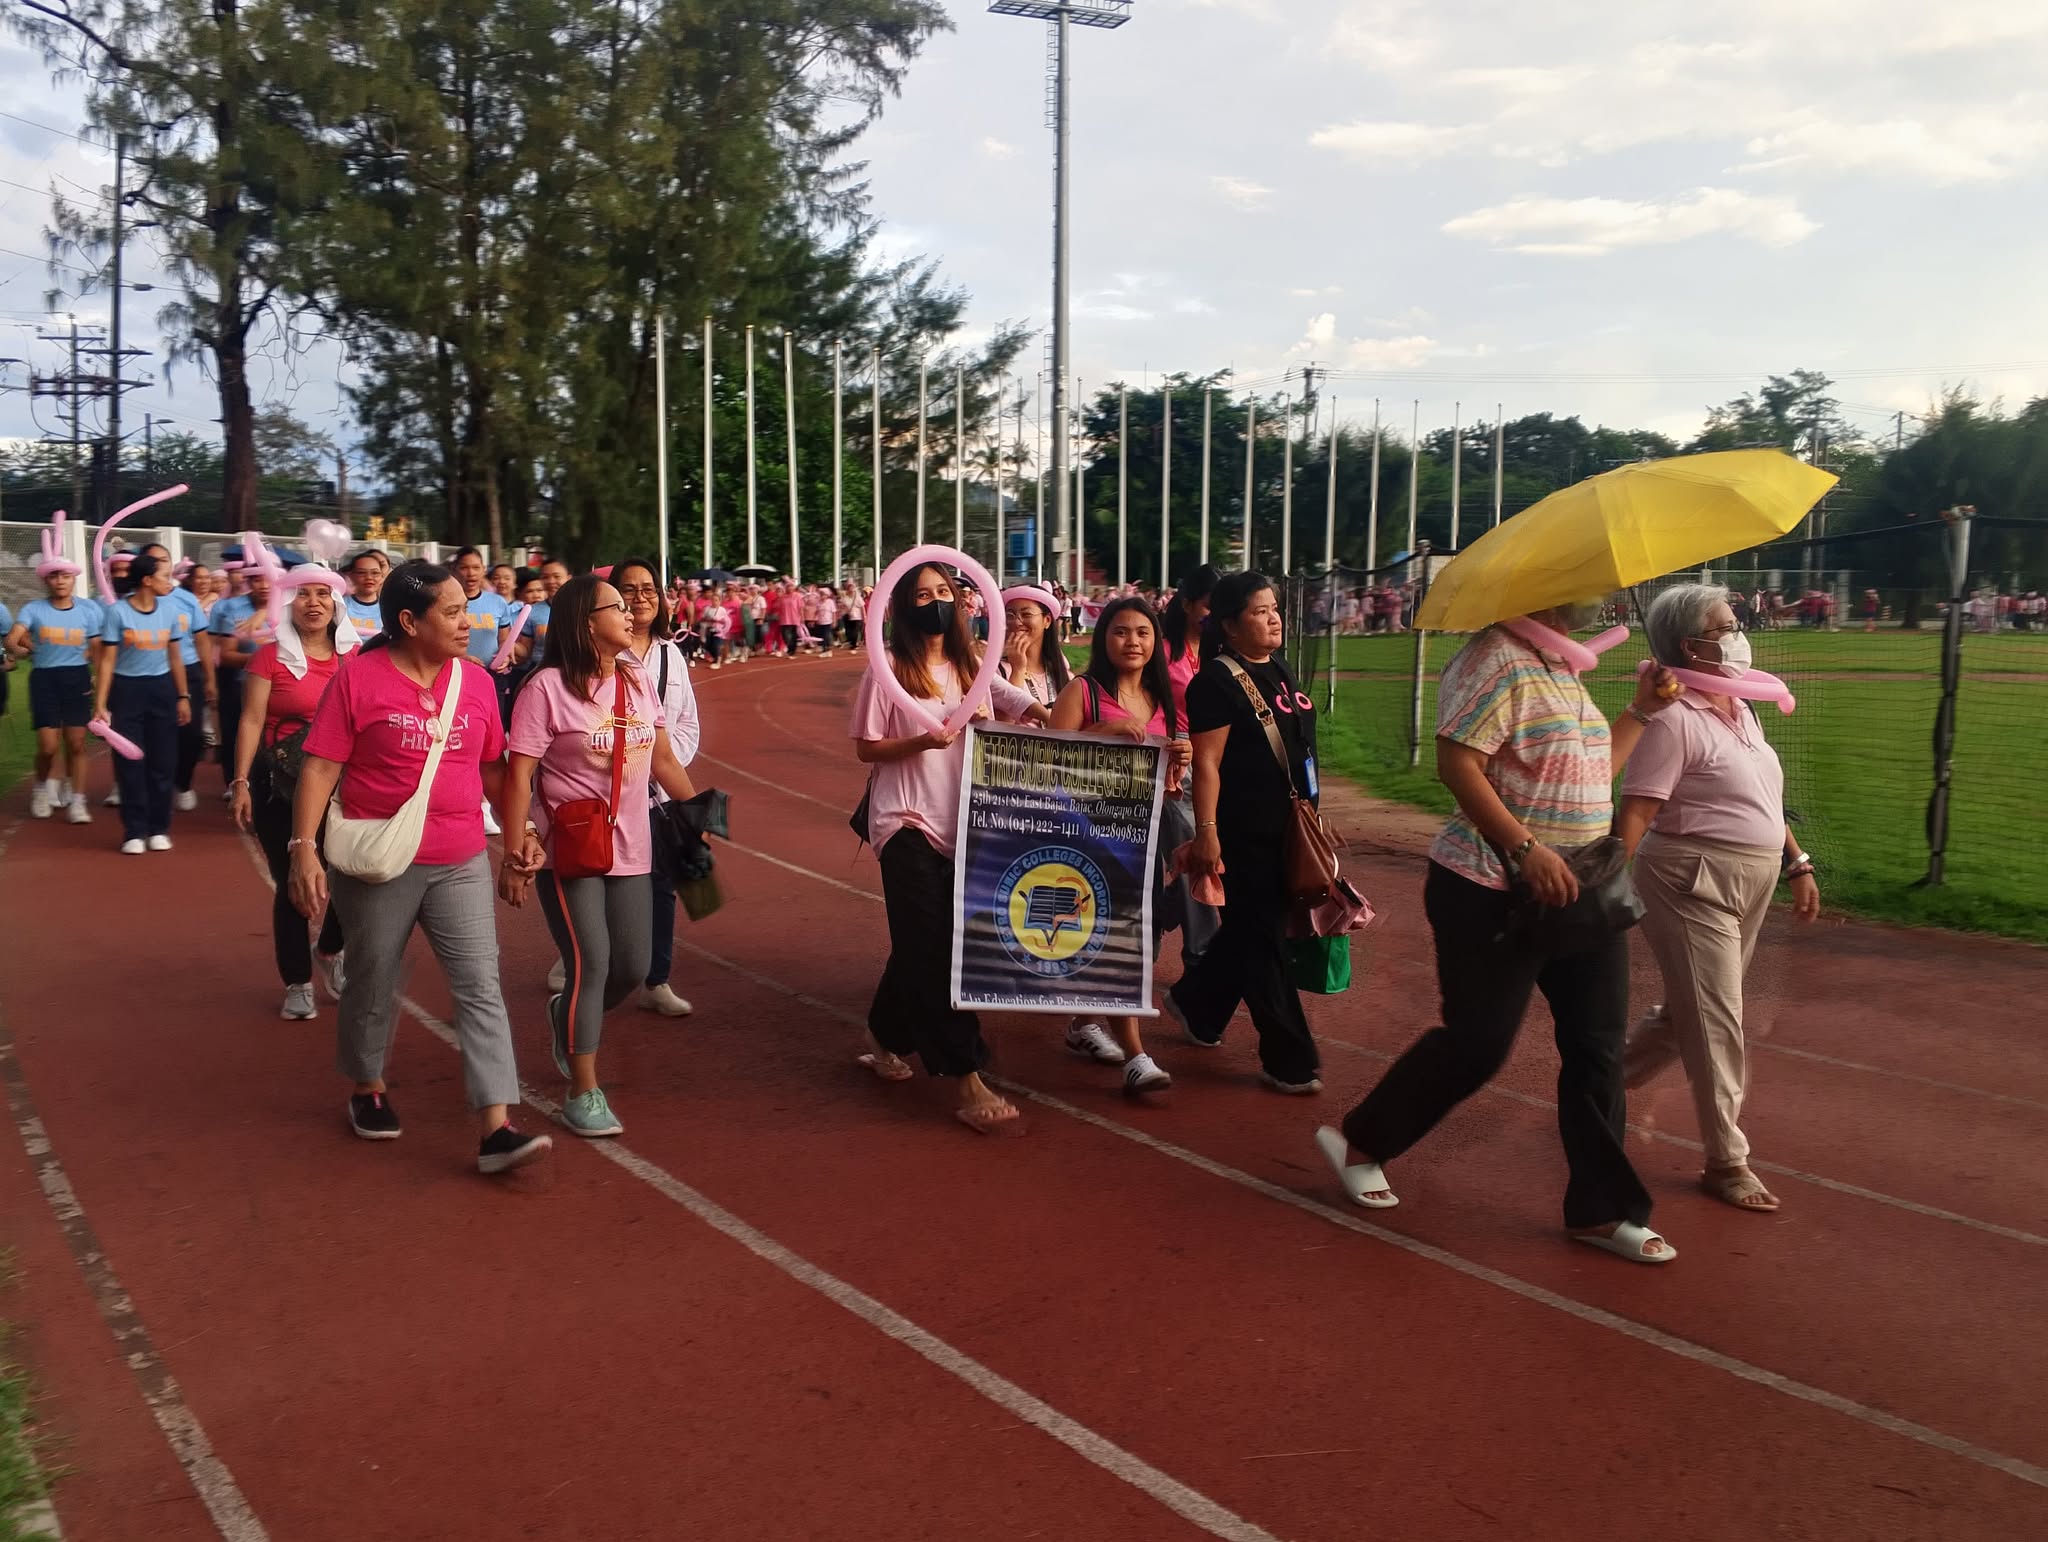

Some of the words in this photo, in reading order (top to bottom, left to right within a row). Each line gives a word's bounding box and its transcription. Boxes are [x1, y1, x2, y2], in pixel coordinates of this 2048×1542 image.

[973, 732, 1018, 788] METRO
[1018, 738, 1060, 793] SUBIC
[1061, 743, 1130, 798] COLLEGES
[1131, 749, 1155, 801] INC.
[1024, 794, 1044, 810] East
[1095, 800, 1133, 820] Olongapo
[972, 810, 988, 828] Tel.
[990, 812, 1008, 830] No.
[1022, 848, 1083, 869] COLLEGES
[1036, 960, 1070, 974] 1993
